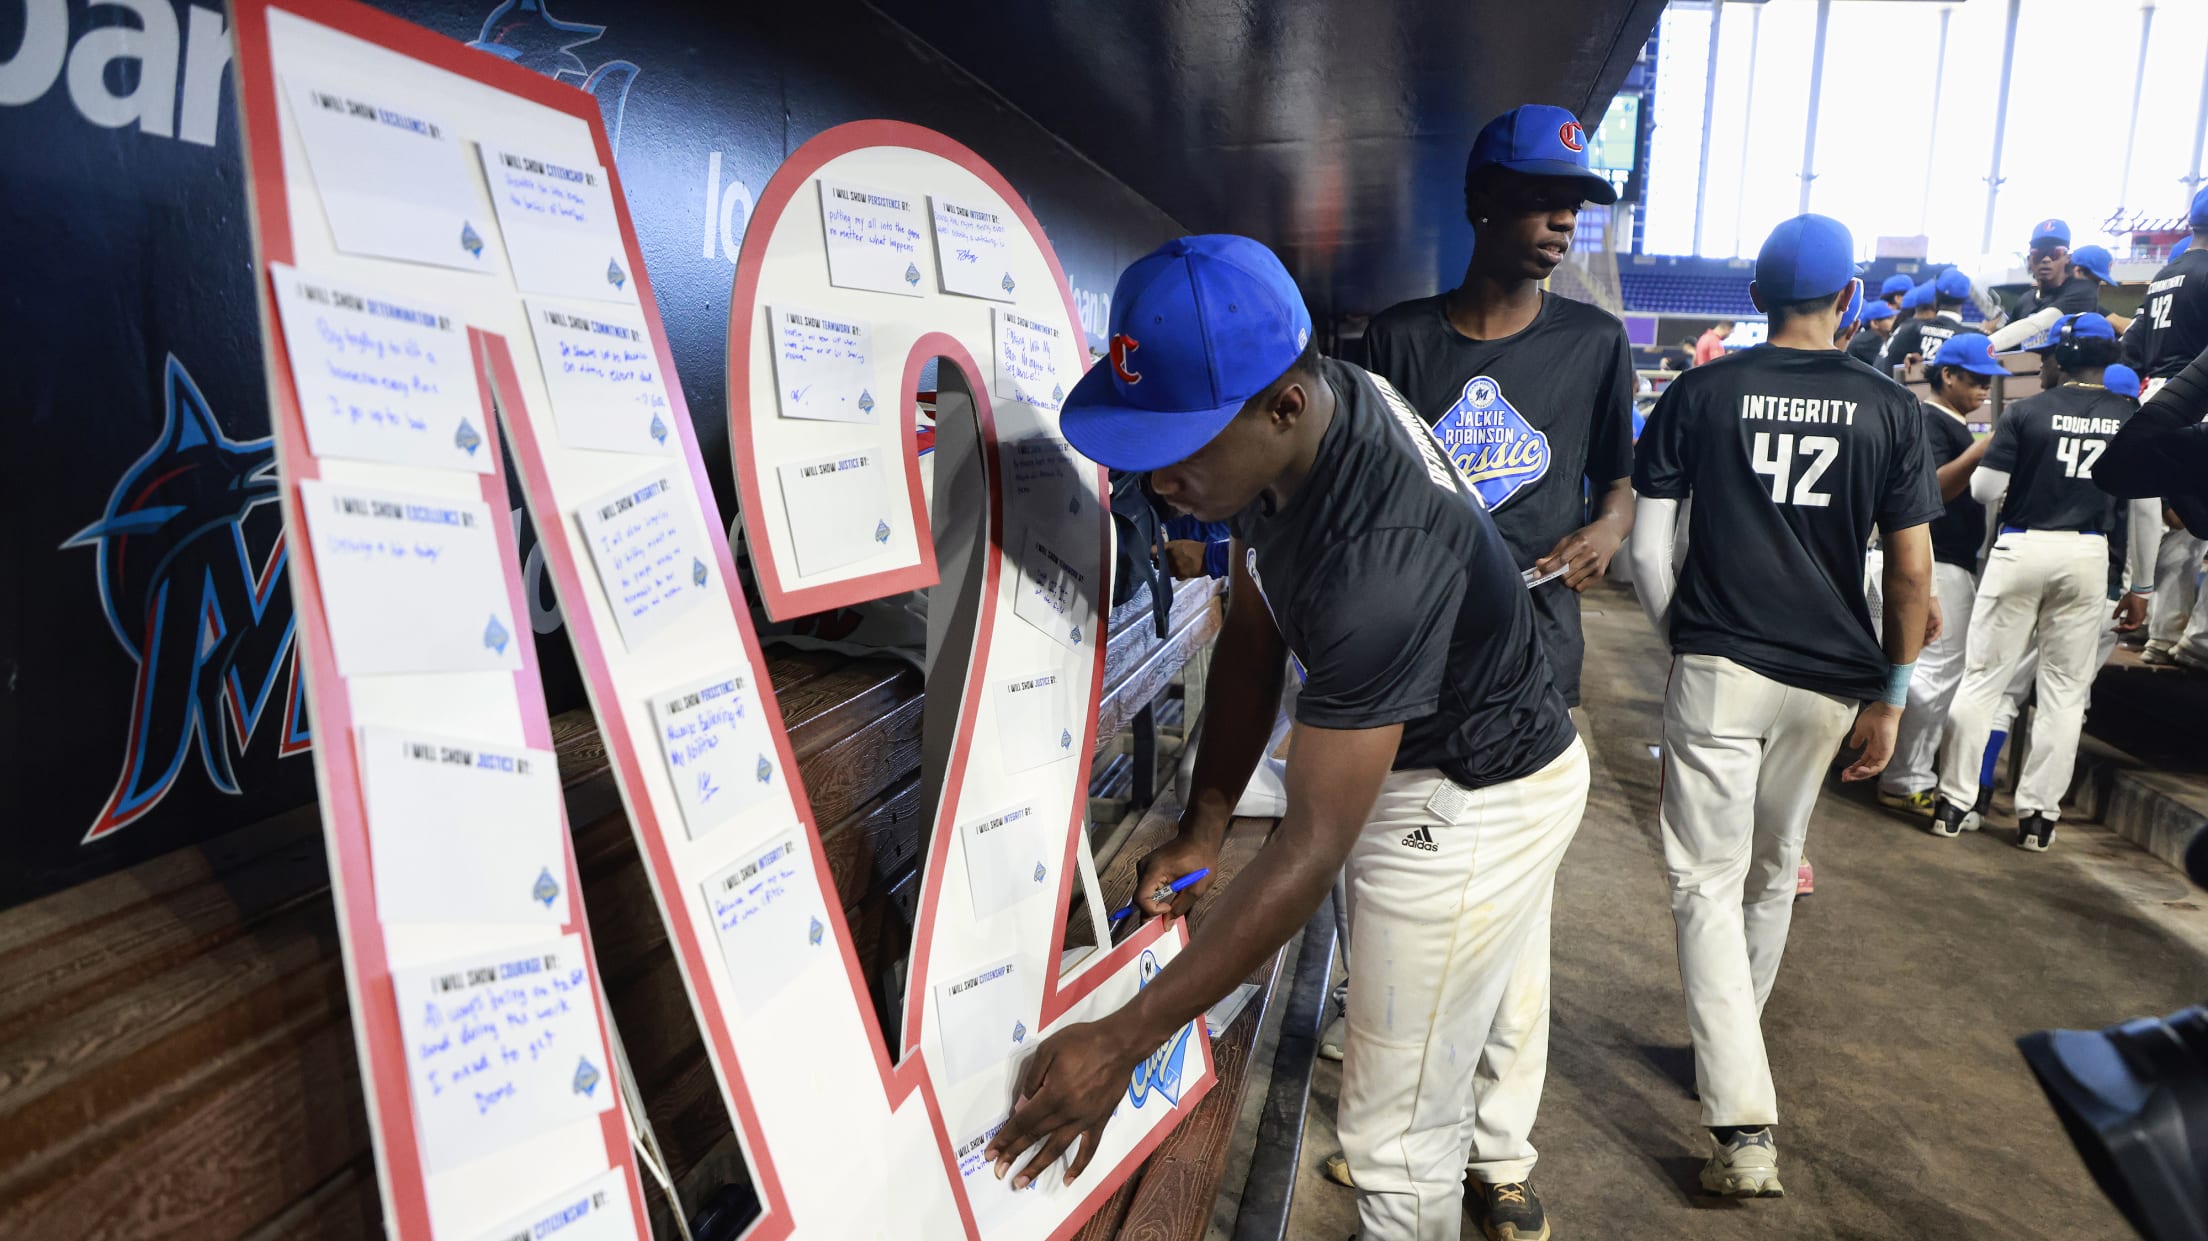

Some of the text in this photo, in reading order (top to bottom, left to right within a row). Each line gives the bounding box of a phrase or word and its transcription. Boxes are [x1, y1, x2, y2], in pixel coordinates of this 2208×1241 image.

[1559, 121, 1583, 152] C
[833, 187, 835, 197] I
[836, 188, 849, 200] WILL
[851, 192, 866, 203] SHOW
[867, 195, 900, 210] PERSISTENCE
[943, 203, 945, 211] I
[946, 204, 955, 214] WILL
[956, 206, 969, 217] SHOW
[786, 312, 789, 322] I
[790, 313, 803, 325] WILL
[804, 316, 820, 328] SHOW
[822, 320, 851, 334] TEAMWORK
[1003, 312, 1006, 320] I
[1007, 313, 1016, 324] WILL
[1017, 317, 1029, 328] SHOW
[2150, 294, 2173, 329] 42
[1110, 333, 1142, 384] C
[1456, 410, 1505, 427] JACKIE
[1742, 394, 1857, 425] INTEGRITY
[1445, 427, 1514, 445] ROBINSON
[2052, 414, 2120, 435] COURAGE
[800, 468, 804, 478] I
[804, 466, 818, 477] WILL
[819, 463, 836, 474] SHOW
[838, 458, 859, 471] JUSTICE
[1436, 433, 1542, 484] lassic
[1752, 432, 1839, 507] 42
[2056, 437, 2106, 479] 42
[1008, 684, 1010, 693] I
[1010, 683, 1021, 693] WILL
[1021, 680, 1034, 691] SHOW
[1035, 677, 1050, 687] JUSTICE
[412, 742, 436, 760] WILL
[441, 746, 472, 766] SHOW
[976, 826, 979, 835] I
[979, 823, 990, 834] WILL
[990, 817, 1003, 830] SHOW
[1004, 809, 1024, 824] INTEGRITY
[1401, 838, 1438, 852] adidas
[722, 880, 727, 892] I
[726, 873, 741, 890] WILL
[740, 862, 758, 881] SHOW
[432, 977, 438, 993] I
[440, 971, 465, 992] WILL
[467, 966, 496, 987] SHOW
[949, 987, 951, 996] I
[952, 984, 964, 995] WILL
[964, 977, 978, 990] SHOW
[979, 966, 1005, 984] CITIZENSHIP
[958, 1144, 970, 1158] WILL
[970, 1135, 984, 1150] SHOW
